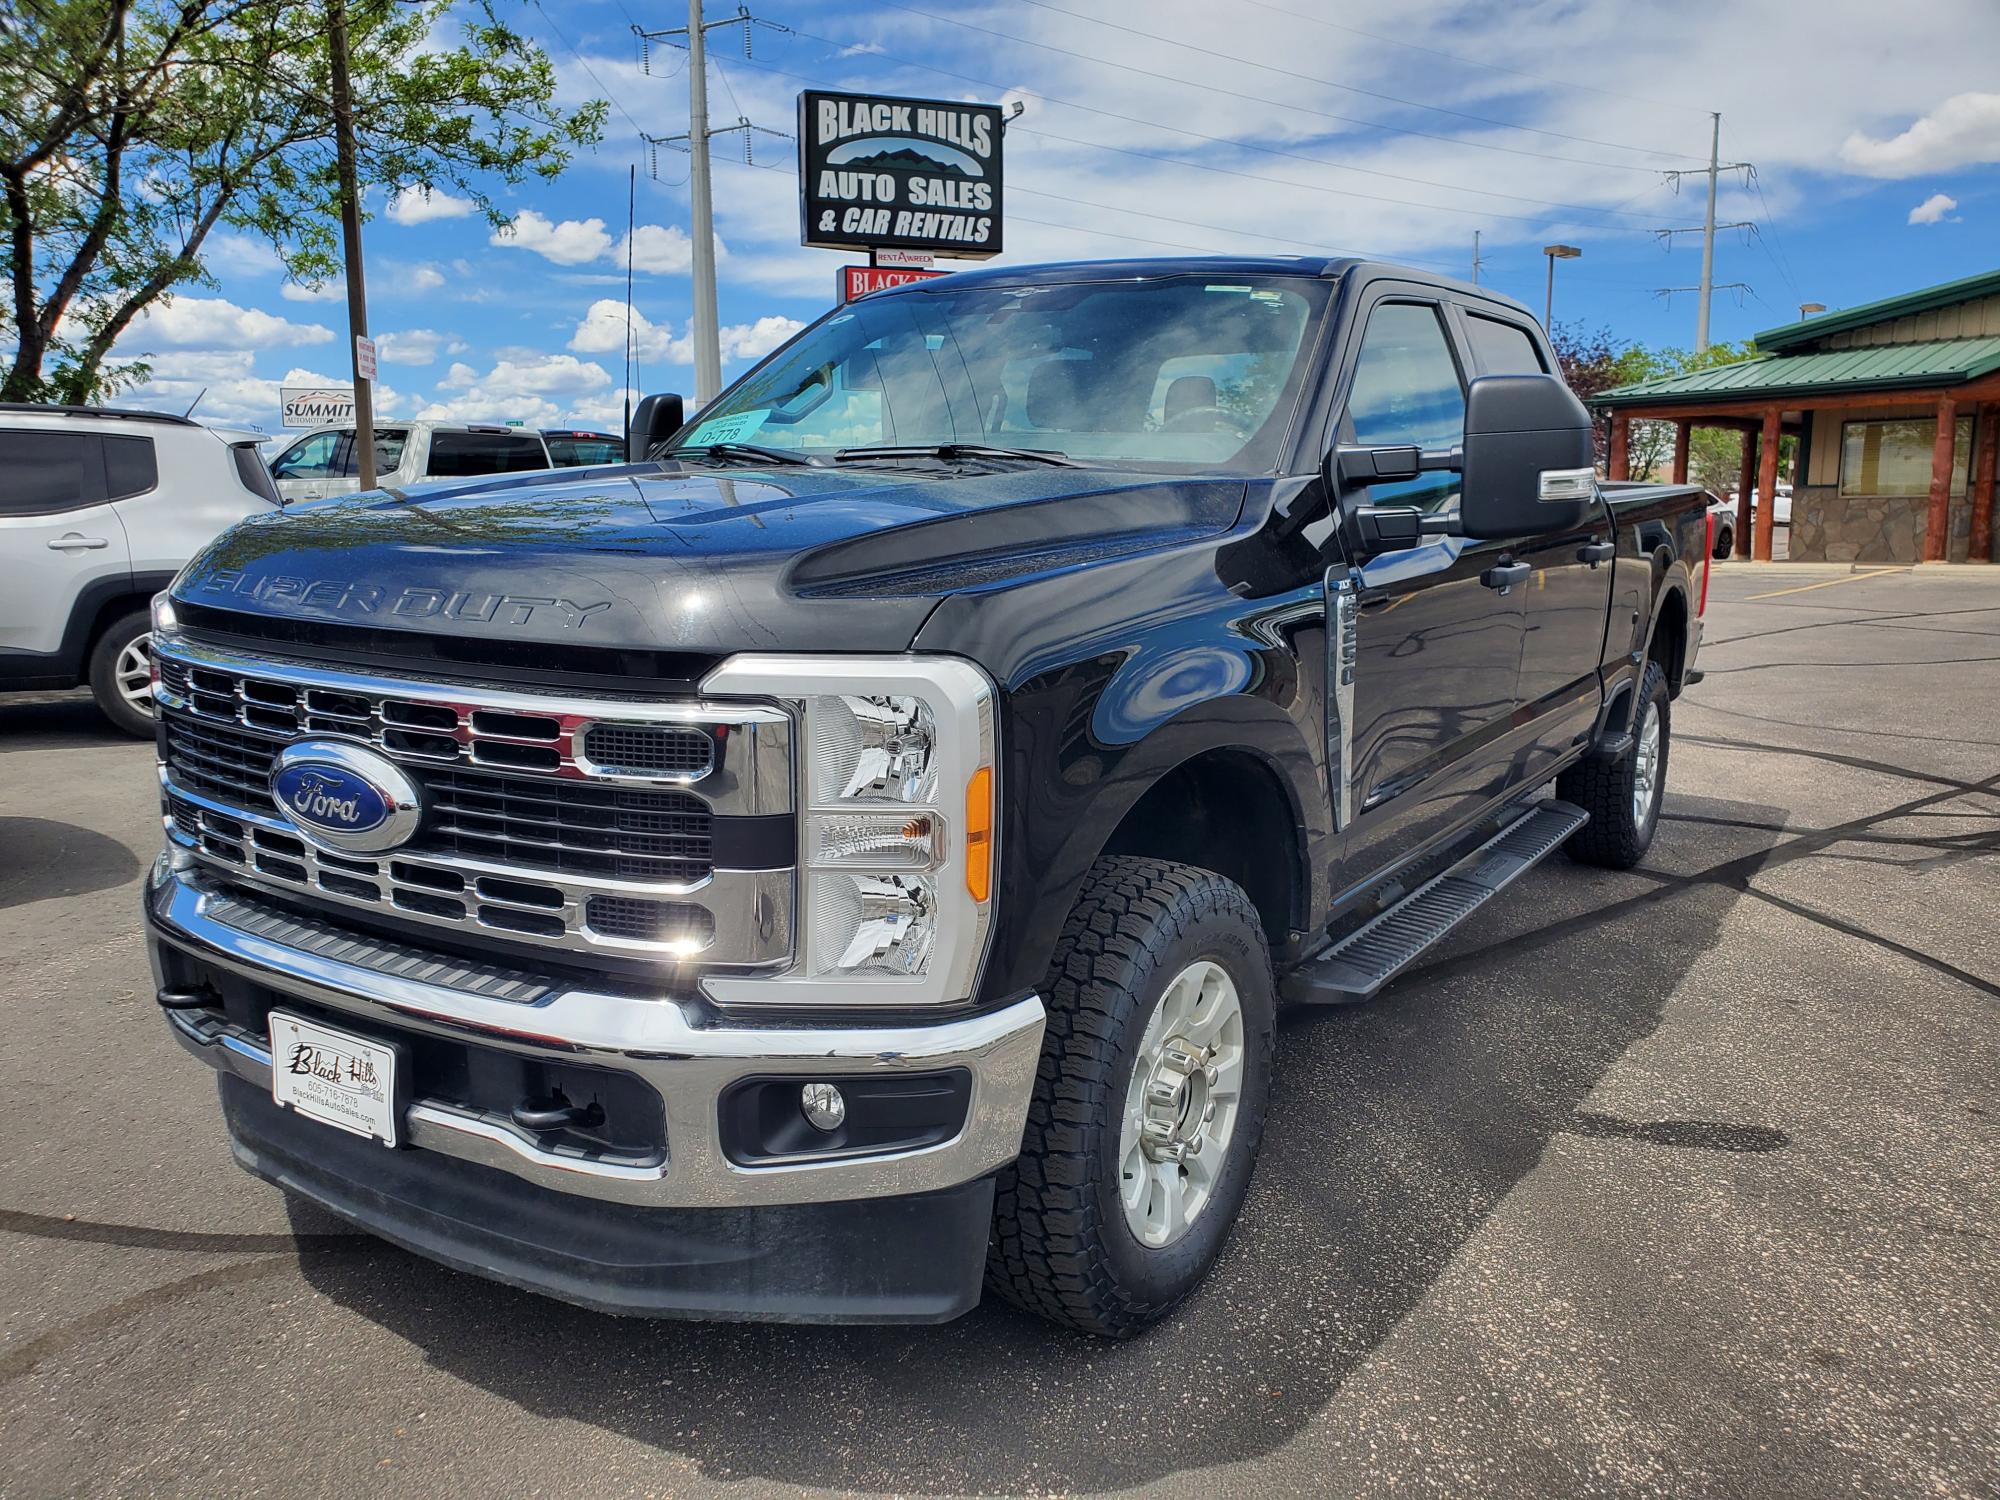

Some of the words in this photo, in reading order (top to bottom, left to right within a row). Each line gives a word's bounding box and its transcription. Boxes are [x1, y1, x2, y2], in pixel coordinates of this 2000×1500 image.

[818, 99, 912, 146] BLACK
[917, 108, 992, 159] HILLS
[818, 170, 896, 203] AUTO
[908, 177, 992, 211] SALES
[818, 209, 836, 232] &
[842, 207, 892, 235] CAR
[894, 210, 992, 243] RENTALS
[285, 404, 355, 417] SUMMIT
[700, 428, 741, 442] D-778
[201, 570, 386, 613] SUPER
[392, 587, 613, 629] DUTY
[293, 772, 360, 823] Ford
[287, 1043, 342, 1083] Black
[346, 1056, 377, 1085] Hills
[292, 1086, 376, 1125] BlackHillsAutoSales.com
